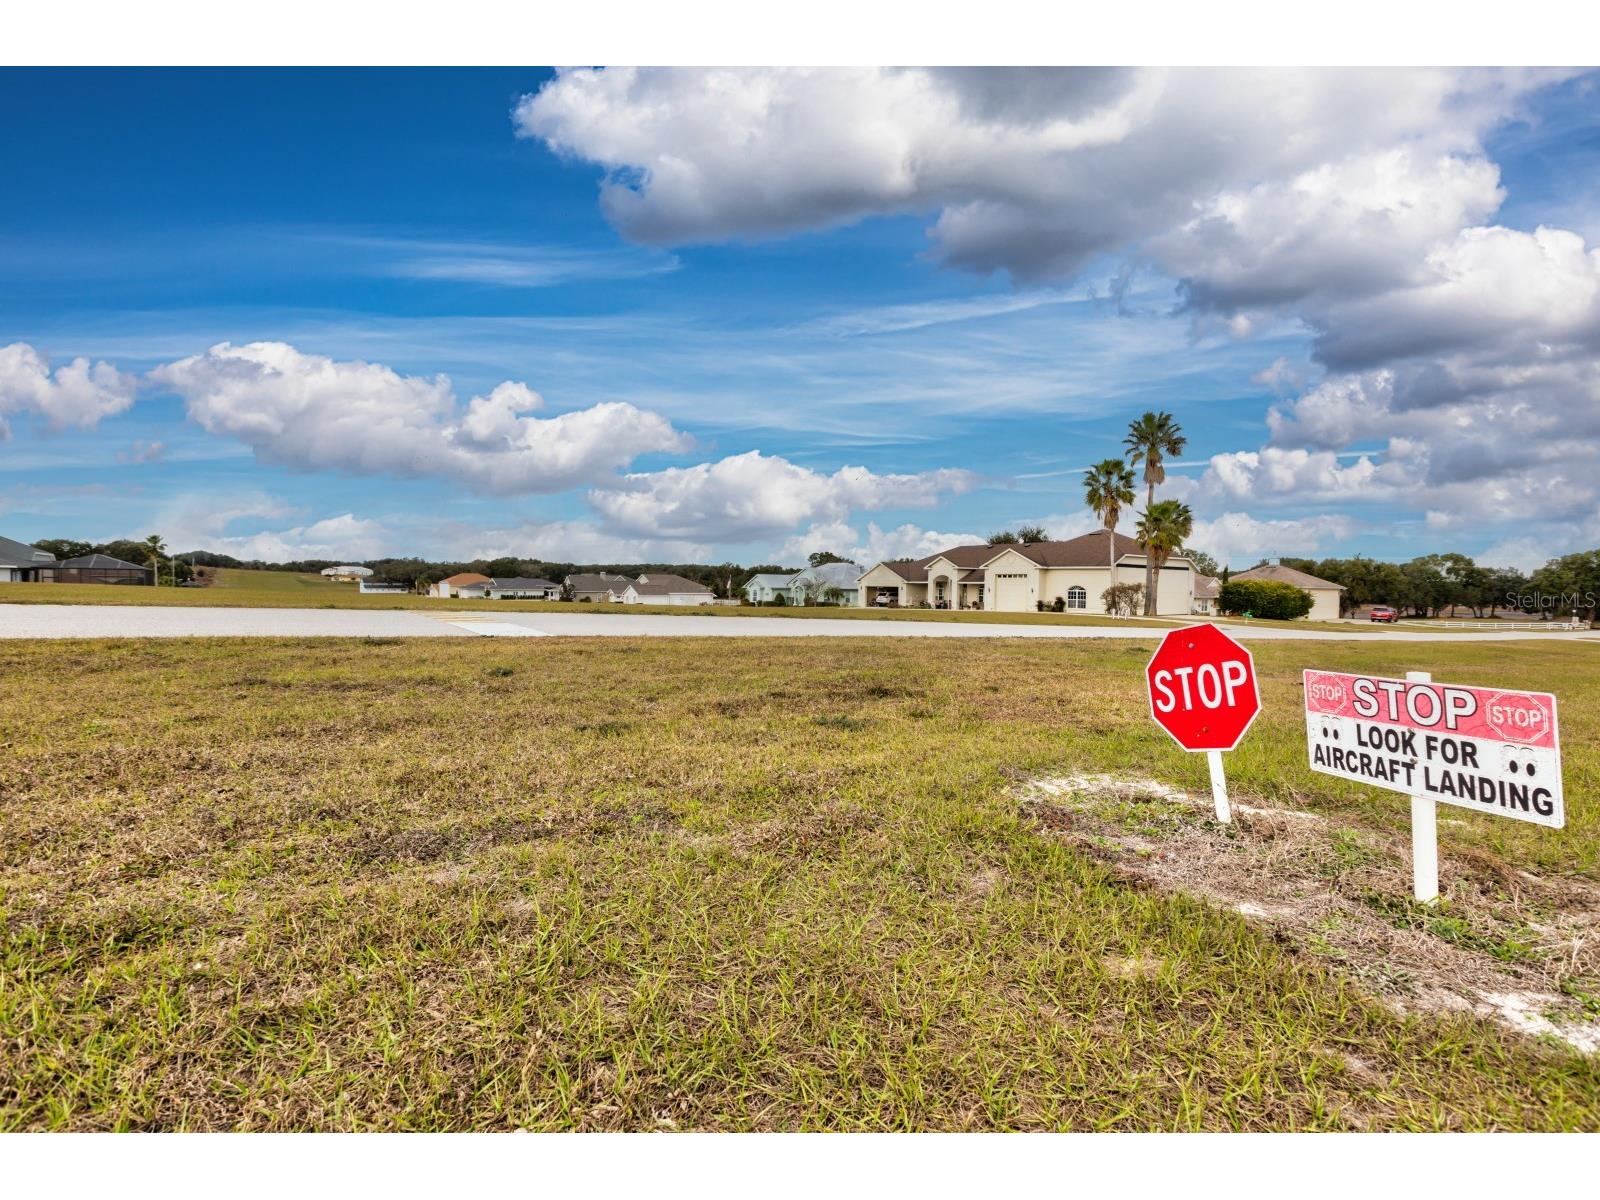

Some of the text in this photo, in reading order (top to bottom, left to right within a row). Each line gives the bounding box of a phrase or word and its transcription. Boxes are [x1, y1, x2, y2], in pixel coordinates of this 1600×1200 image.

[1154, 660, 1248, 713] STOP
[1312, 684, 1342, 701] STOP
[1352, 678, 1477, 730] STOP
[1491, 706, 1542, 728] STOP
[1356, 723, 1479, 769] LOOK FOR
[1313, 743, 1554, 817] AIRCRAFT LANDING
